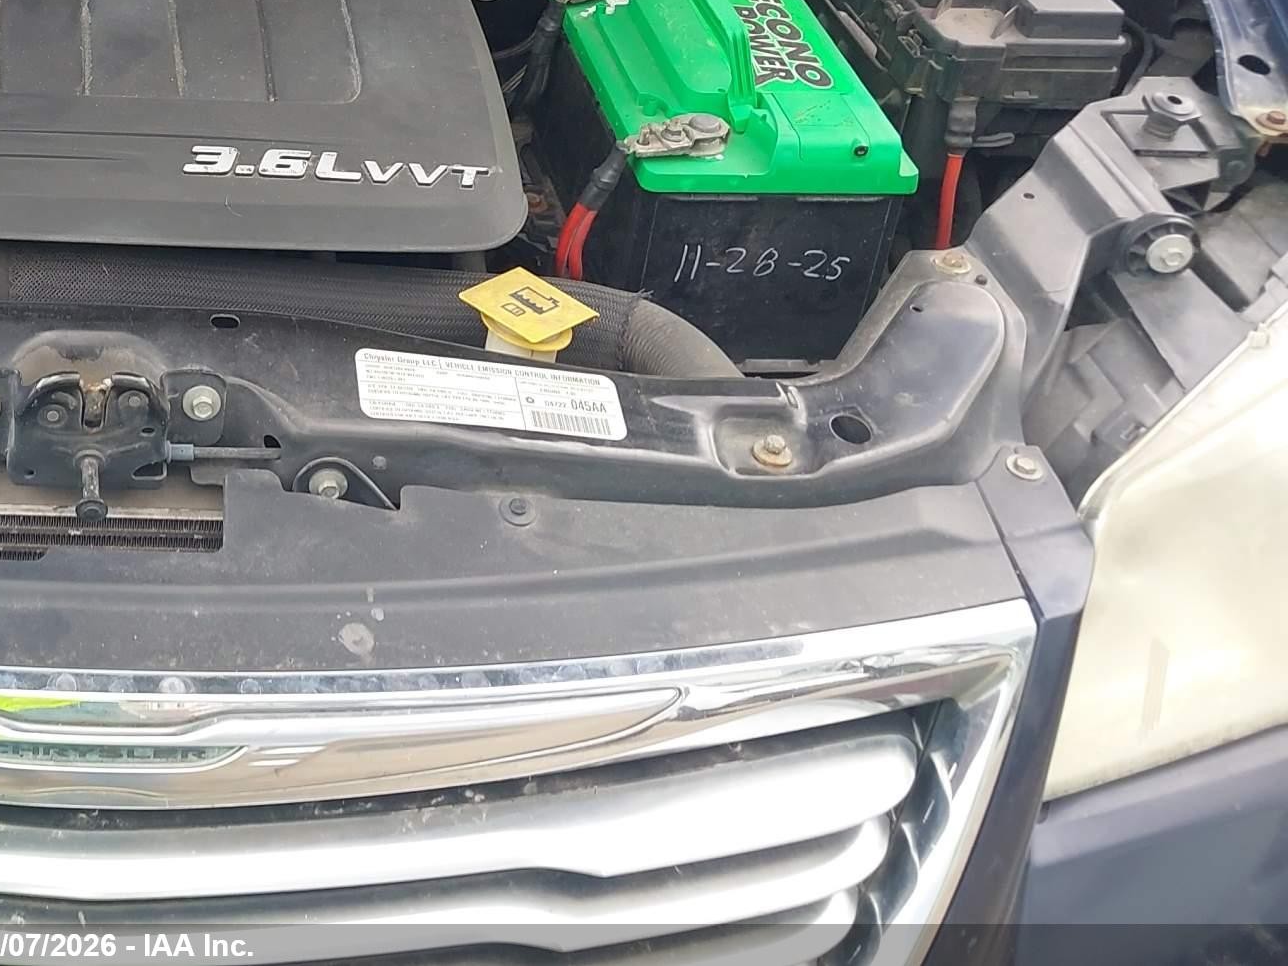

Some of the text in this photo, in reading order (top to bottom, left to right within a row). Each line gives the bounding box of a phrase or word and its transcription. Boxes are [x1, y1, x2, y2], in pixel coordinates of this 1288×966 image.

[734, 4, 797, 89] POWER
[363, 353, 394, 363] Chrysler
[397, 356, 421, 366] Group
[445, 361, 474, 371] VEHICLE
[477, 365, 512, 375] EMISSION
[515, 369, 548, 380] CONTROL
[551, 373, 601, 385] INFORMATION
[570, 398, 607, 413] 045AA
